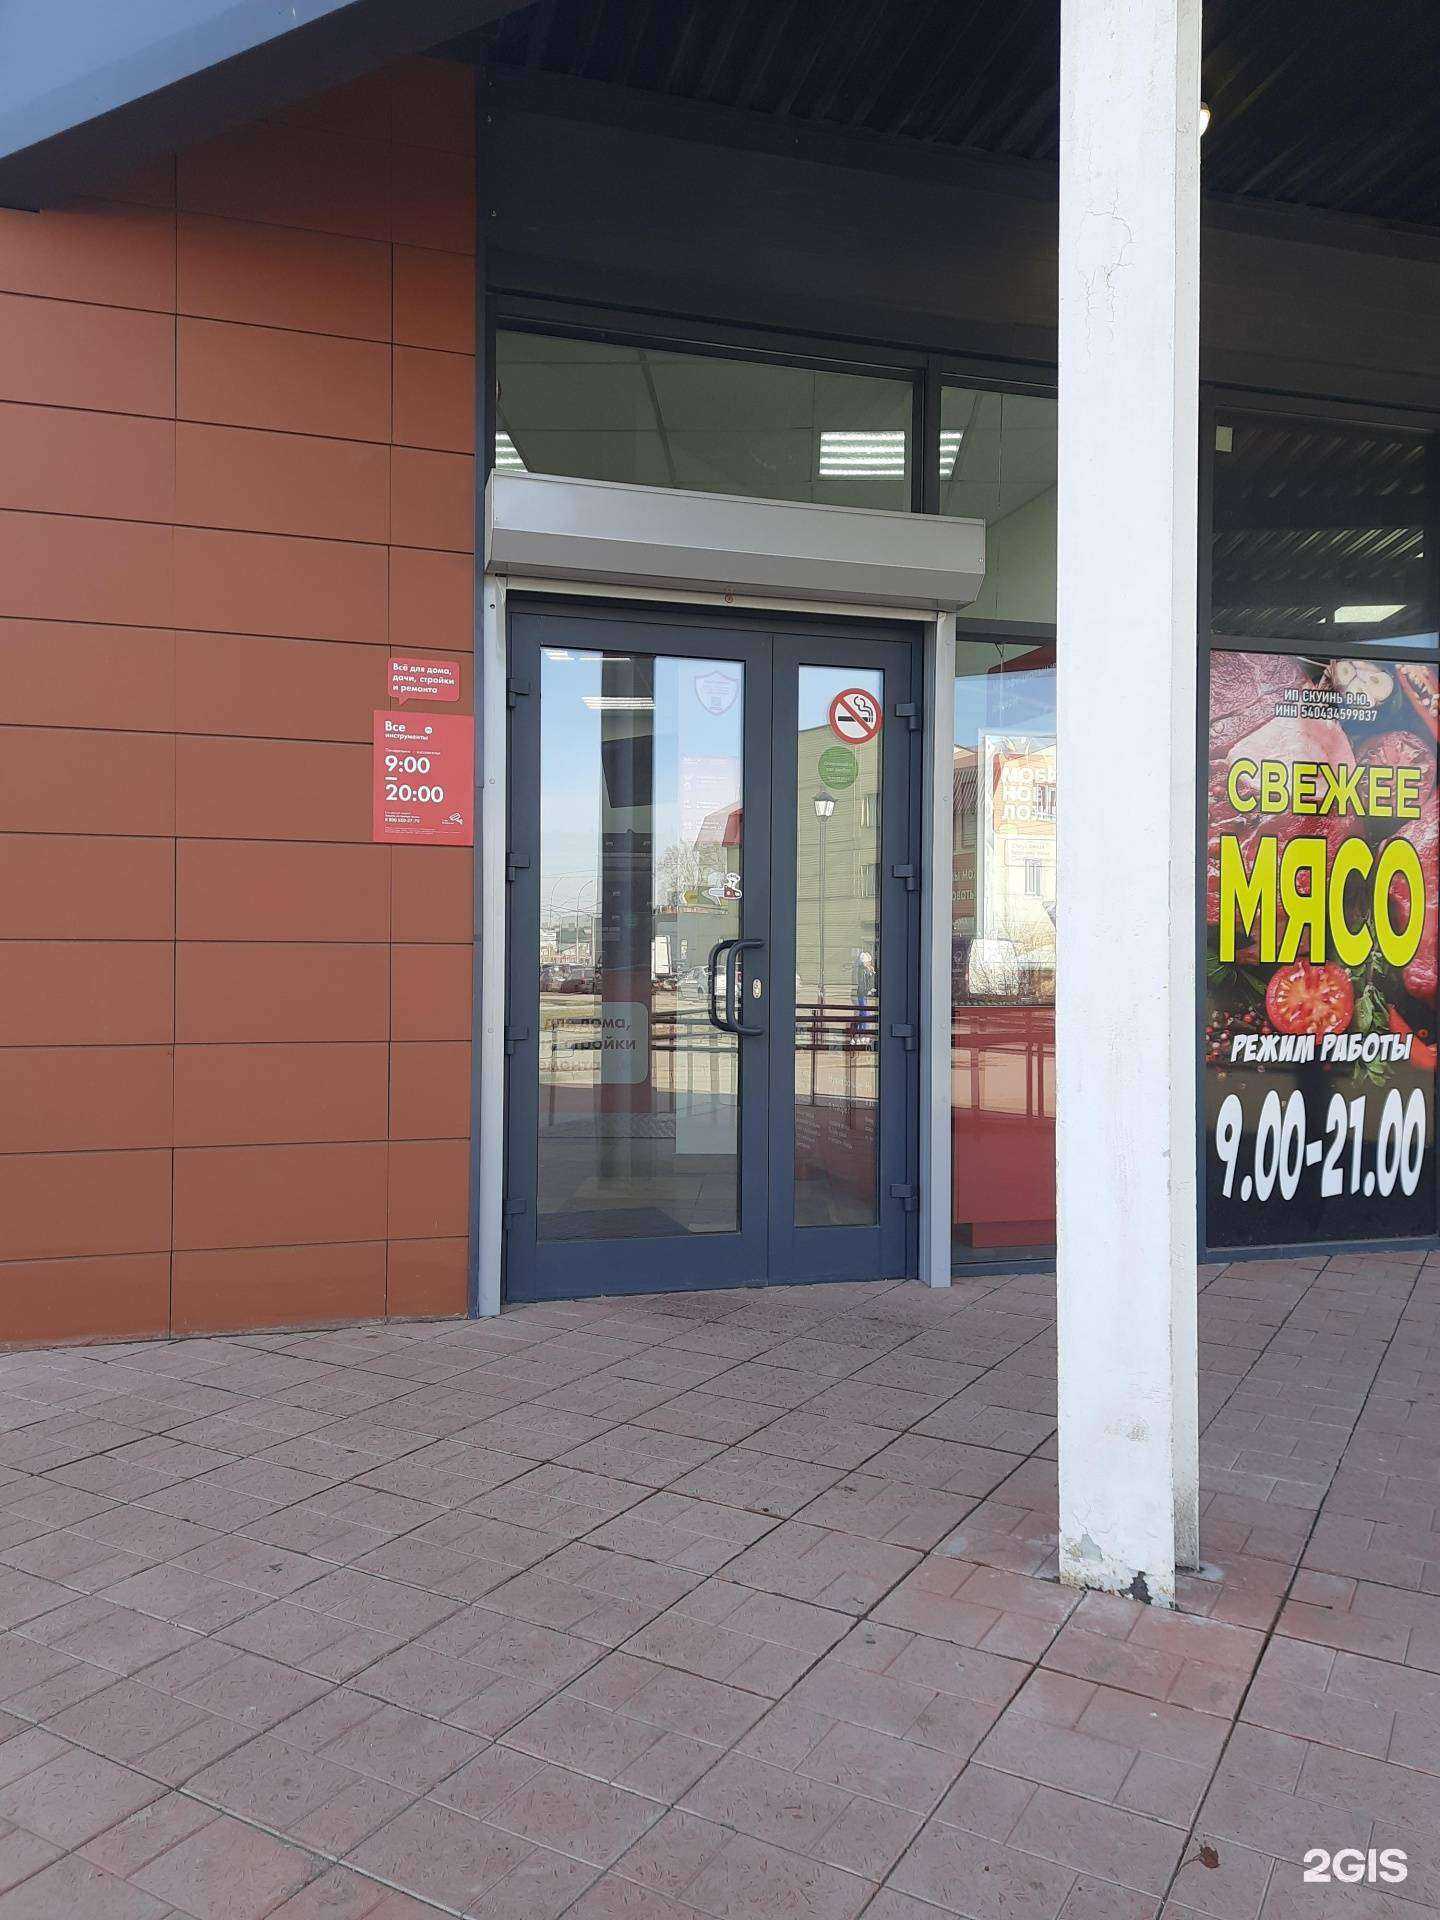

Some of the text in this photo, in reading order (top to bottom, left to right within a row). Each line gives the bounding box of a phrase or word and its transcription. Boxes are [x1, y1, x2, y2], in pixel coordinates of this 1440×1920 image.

[393, 675, 455, 685] дачи, стройки
[427, 667, 452, 675] дома,
[400, 685, 438, 694] ремонта
[1283, 688, 1299, 701] ИП
[1302, 689, 1343, 704] СКУИНЬ
[1275, 703, 1378, 722] ИНН 540434599837
[385, 720, 406, 732] Все
[384, 754, 431, 774] 9:00
[384, 783, 445, 803] 20:00
[1227, 757, 1423, 819] СВЕЖЕЕ
[1219, 832, 1427, 967] МЯСО
[1230, 1032, 1414, 1063] РЕЖИМ РАБОТЫ
[1216, 1088, 1426, 1202] 9.00-21.00
